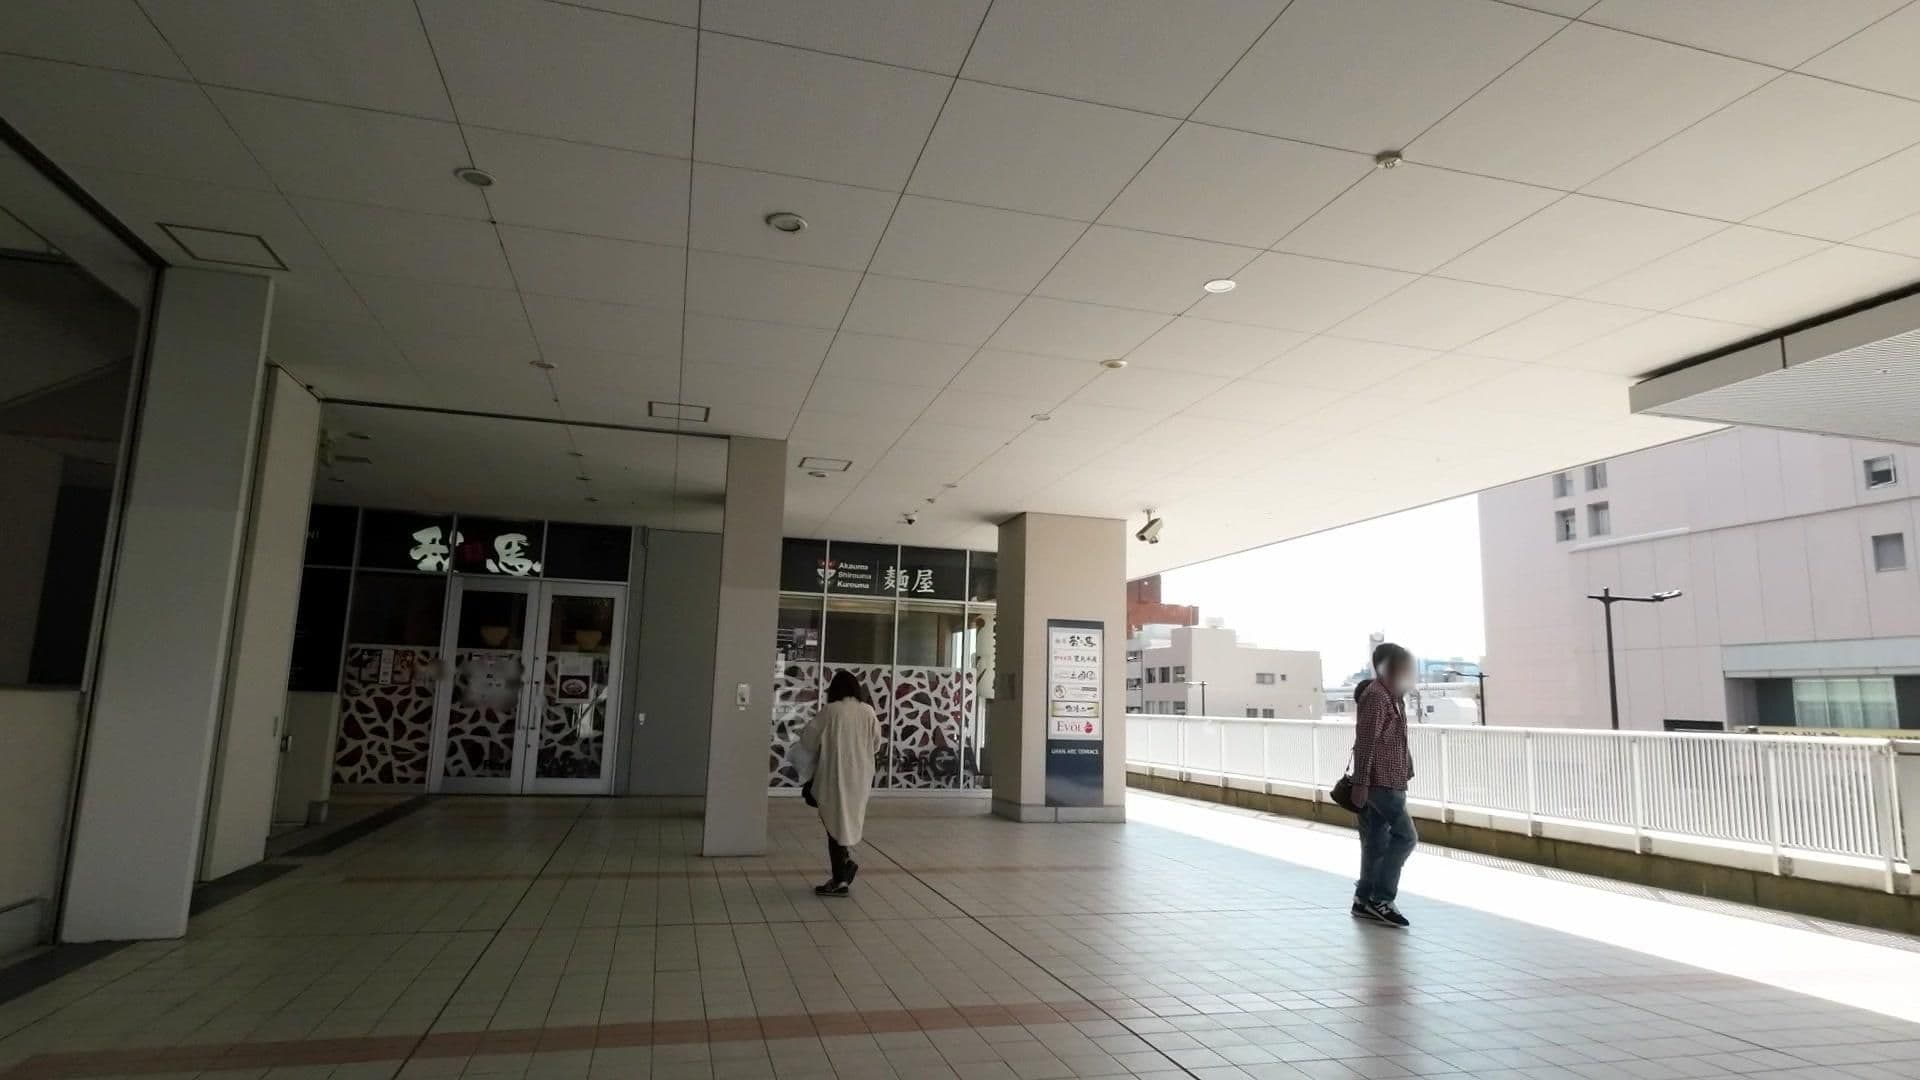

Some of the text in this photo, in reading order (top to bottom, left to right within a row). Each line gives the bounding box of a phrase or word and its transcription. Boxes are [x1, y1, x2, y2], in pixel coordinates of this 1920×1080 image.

[838, 562, 869, 571] Akauma
[884, 565, 935, 593] 麺屋
[837, 581, 870, 589] Kurouma
